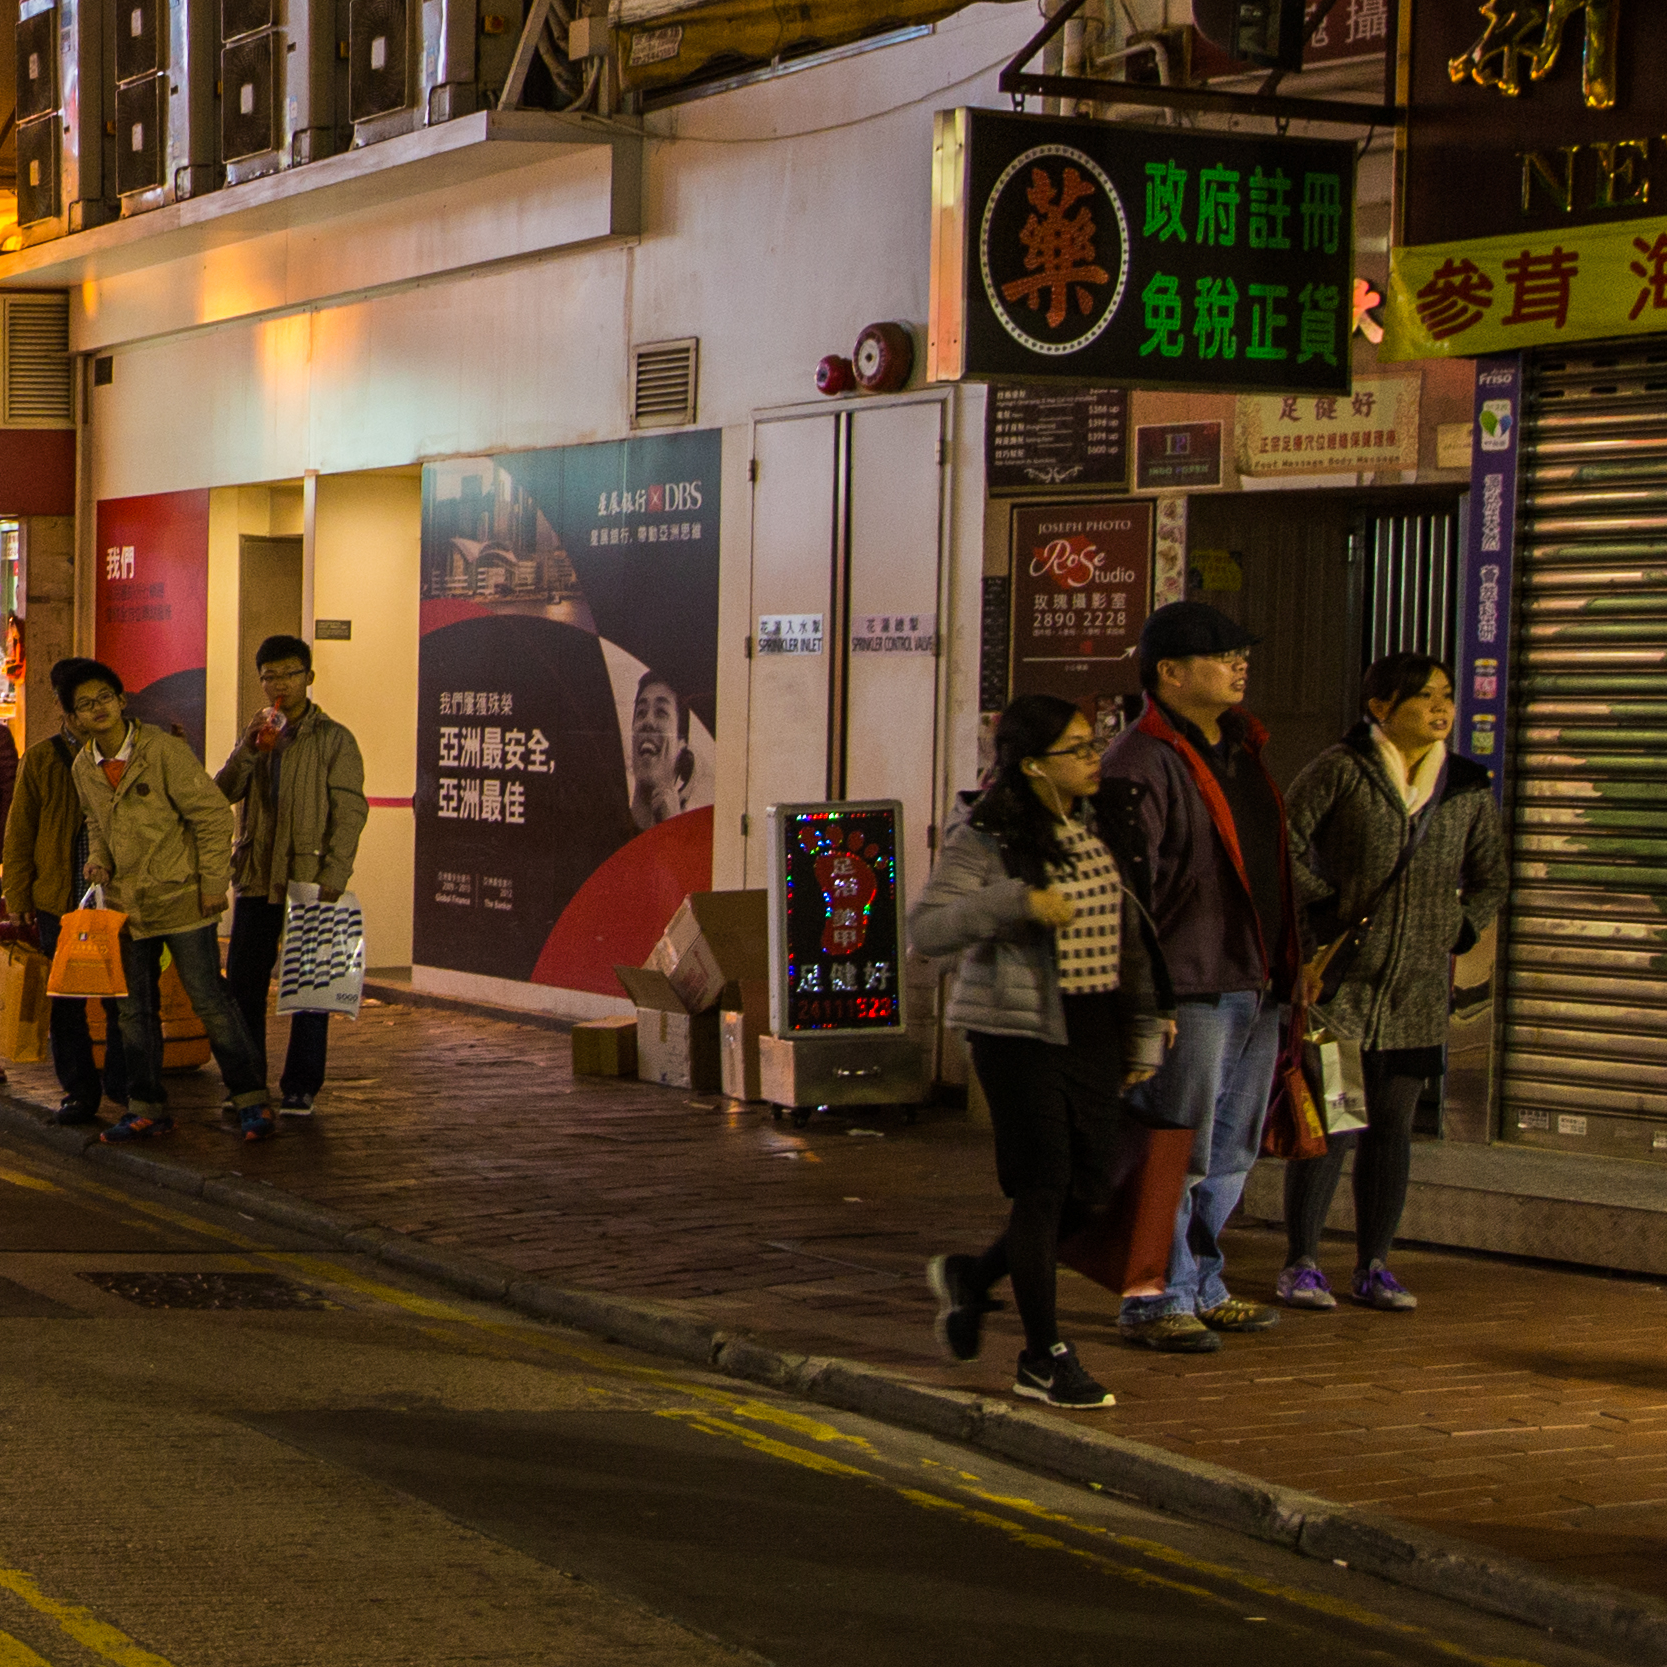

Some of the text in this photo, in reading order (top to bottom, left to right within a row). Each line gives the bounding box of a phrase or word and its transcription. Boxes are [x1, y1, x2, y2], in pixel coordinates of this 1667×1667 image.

[1143, 160, 1343, 255] 政府註冊
[1417, 247, 1579, 340] 參茸
[1140, 272, 1339, 367] 免稅正貨
[664, 480, 702, 512] DBS
[1039, 520, 1132, 535] JOSEPH PHOTO
[106, 545, 135, 580] 我們
[1034, 611, 1127, 628] 2890 2228
[758, 637, 823, 653] SPRINKLER INLET
[852, 638, 883, 652] SPRINKLER
[885, 637, 913, 652] CONTROL
[438, 726, 556, 774] 亞洲最安全,
[437, 777, 526, 825] 亞洲最佳
